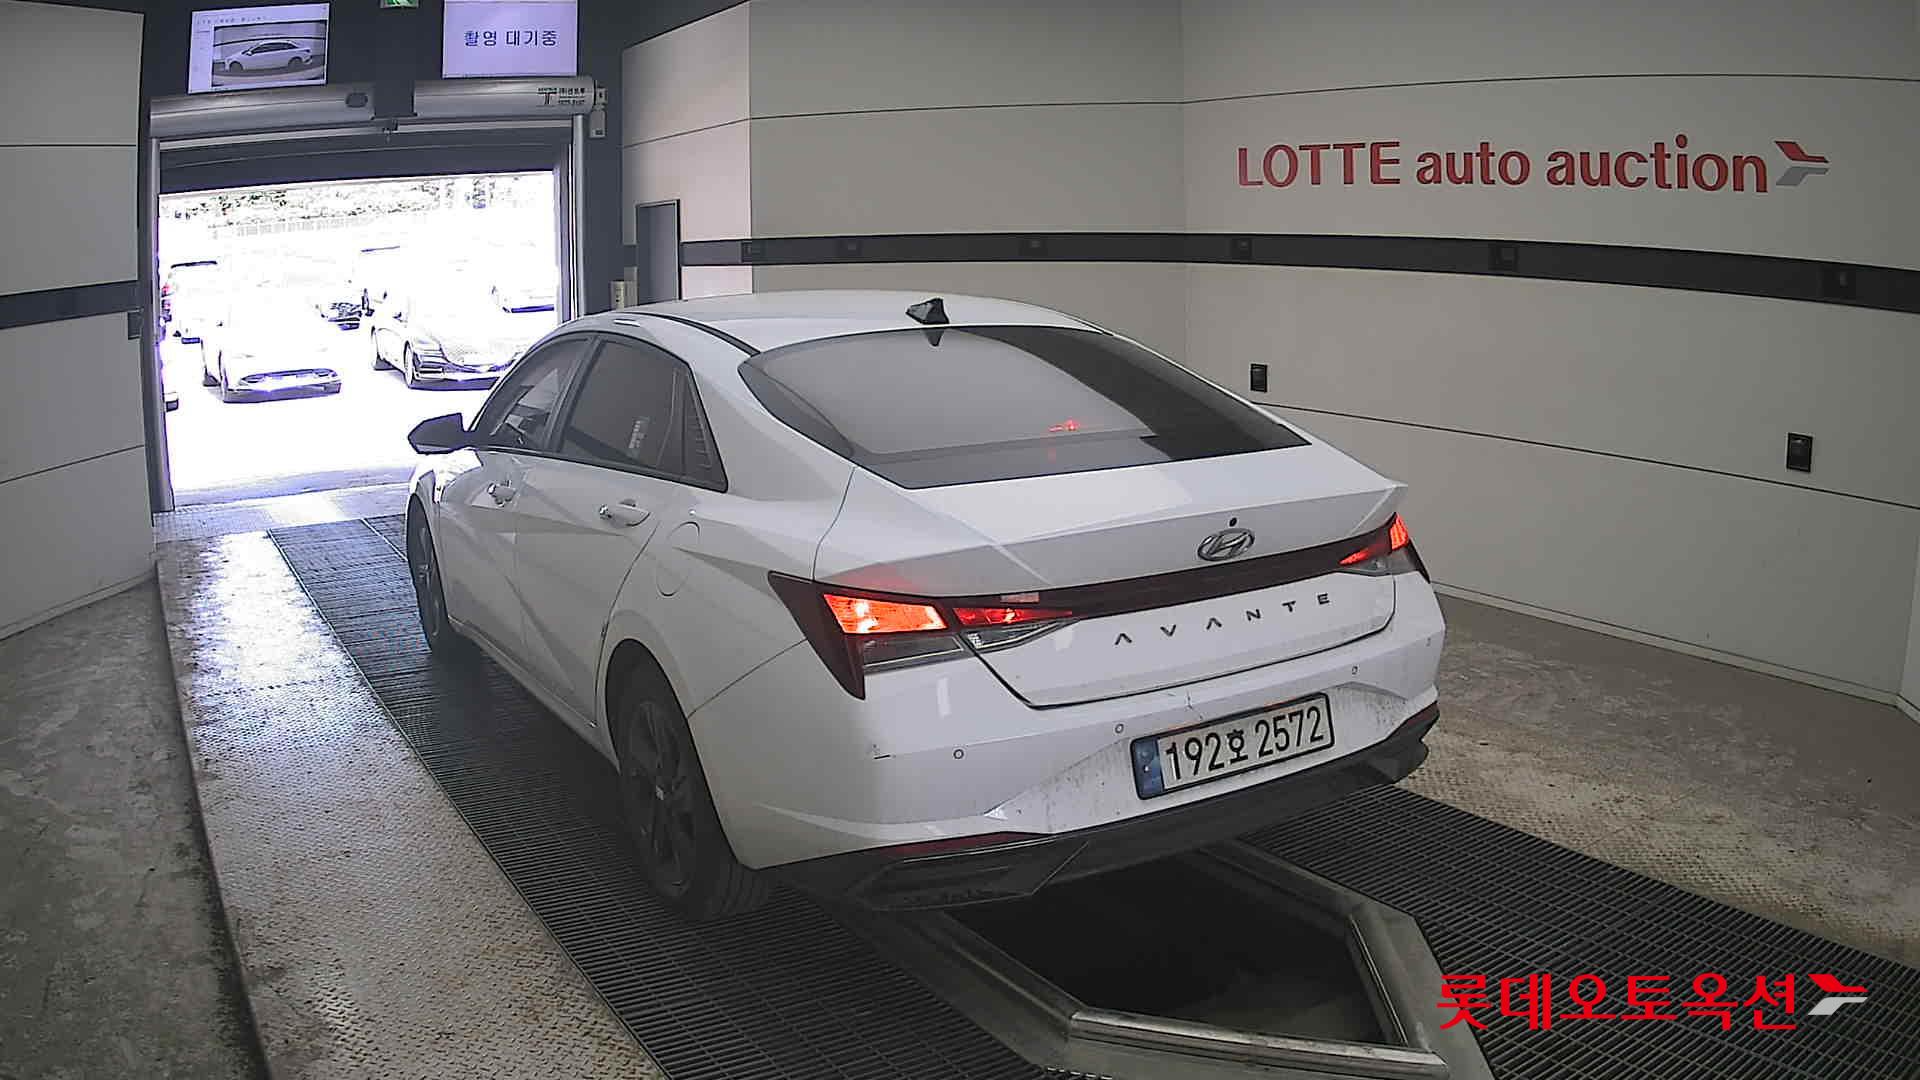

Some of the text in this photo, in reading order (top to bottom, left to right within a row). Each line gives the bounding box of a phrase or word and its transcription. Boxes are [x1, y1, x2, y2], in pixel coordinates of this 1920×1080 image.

[464, 30, 557, 47] 촬영 대기중
[1237, 134, 1768, 193] LOTTE auto auction
[1114, 592, 1331, 646] AVANTE
[1164, 705, 1325, 781] 192호 2572
